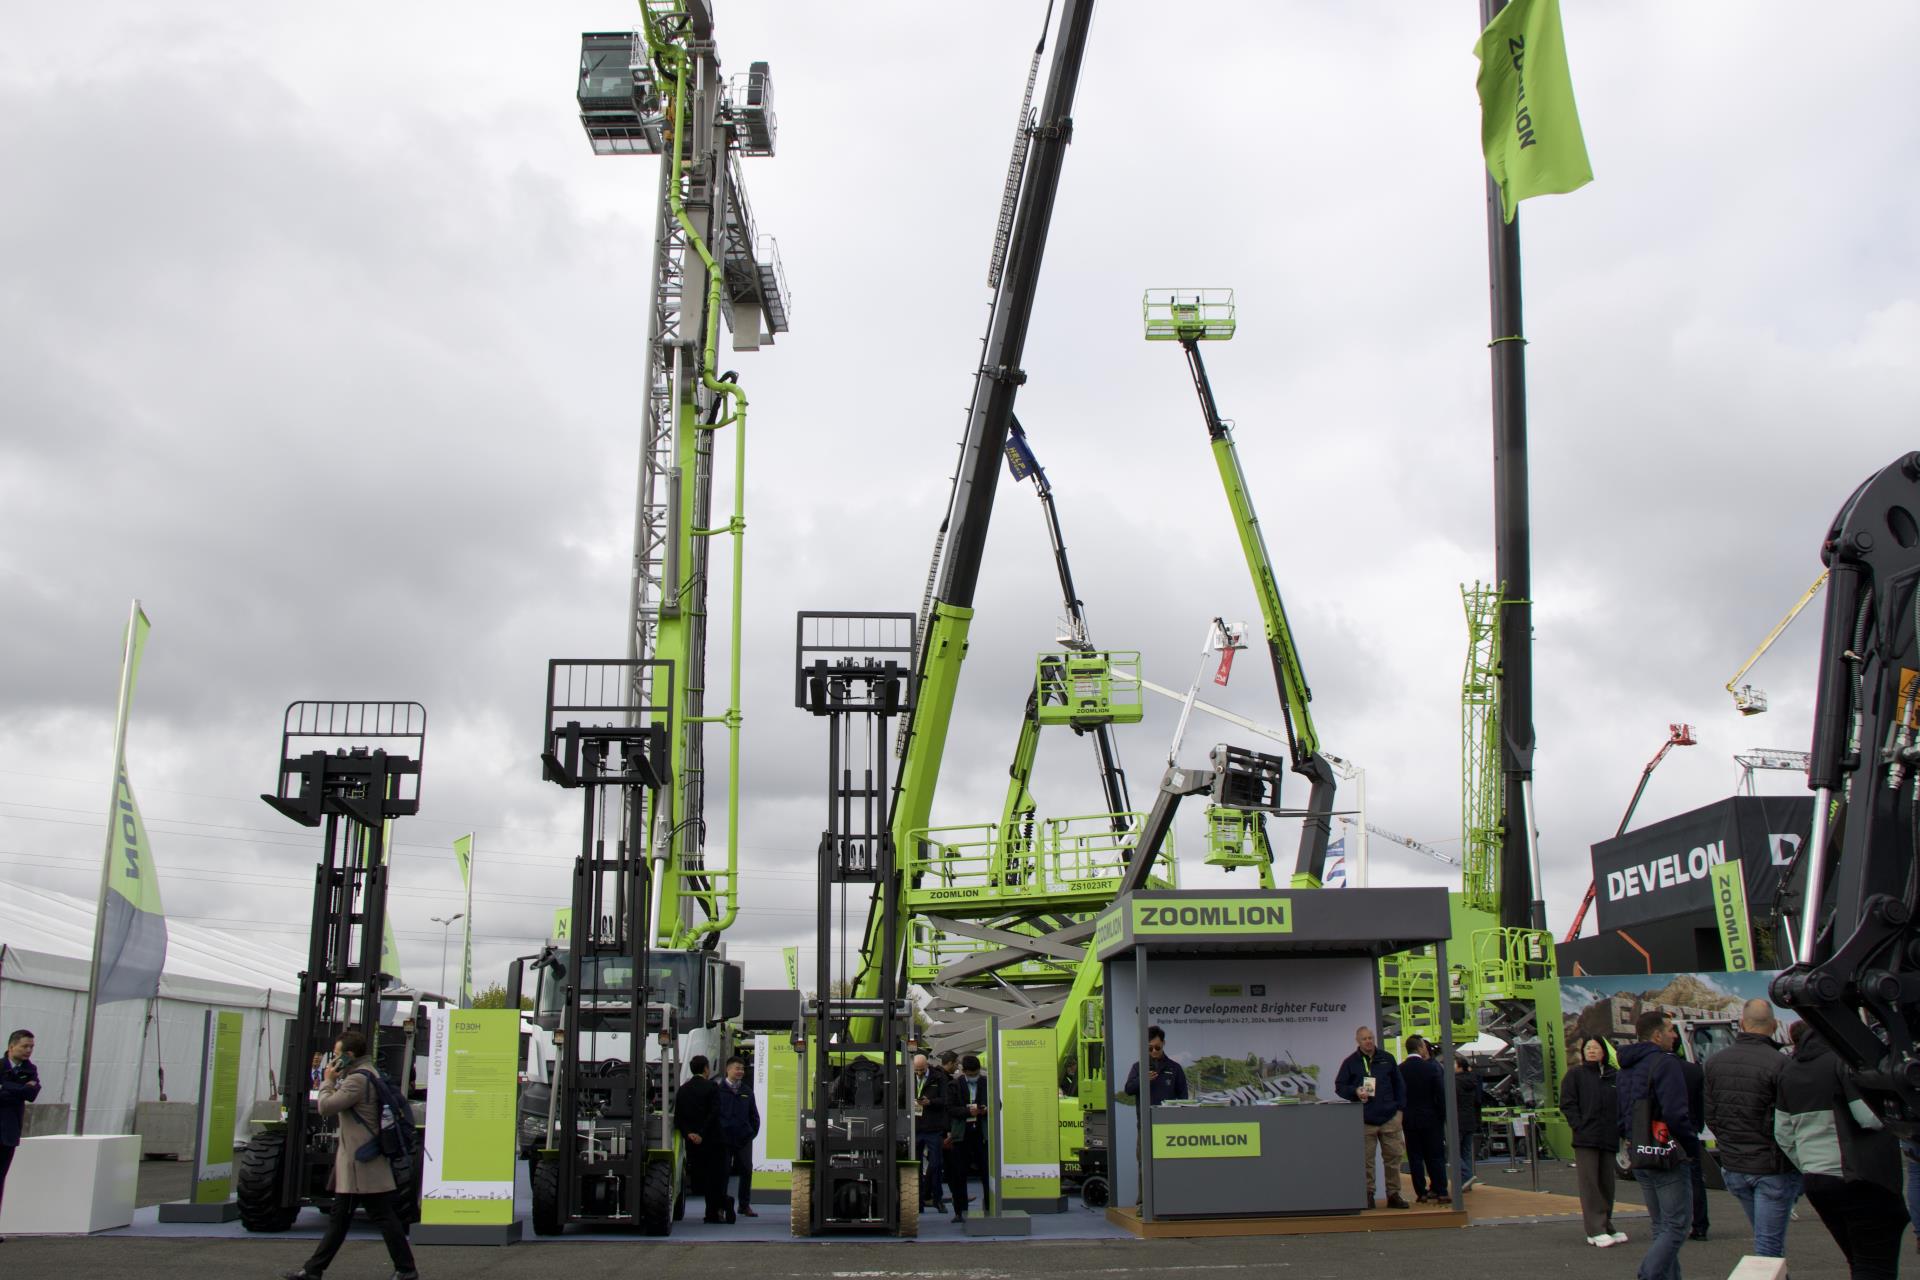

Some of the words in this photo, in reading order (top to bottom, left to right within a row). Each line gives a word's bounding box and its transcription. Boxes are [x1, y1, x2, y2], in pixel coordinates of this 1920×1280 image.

[1607, 840, 1726, 902] DEVELON
[1071, 880, 1113, 891] ZS1023RT
[930, 889, 979, 899] ZOOMLION
[1140, 906, 1285, 926] ZOOMLION
[1719, 874, 1747, 972] ZOOMLIO
[1184, 1002, 1258, 1016] Development
[1261, 1002, 1307, 1015] Brighter
[1310, 1002, 1347, 1013] Future
[455, 1022, 481, 1031] FD30H
[1166, 1134, 1248, 1147] ZOOMLION
